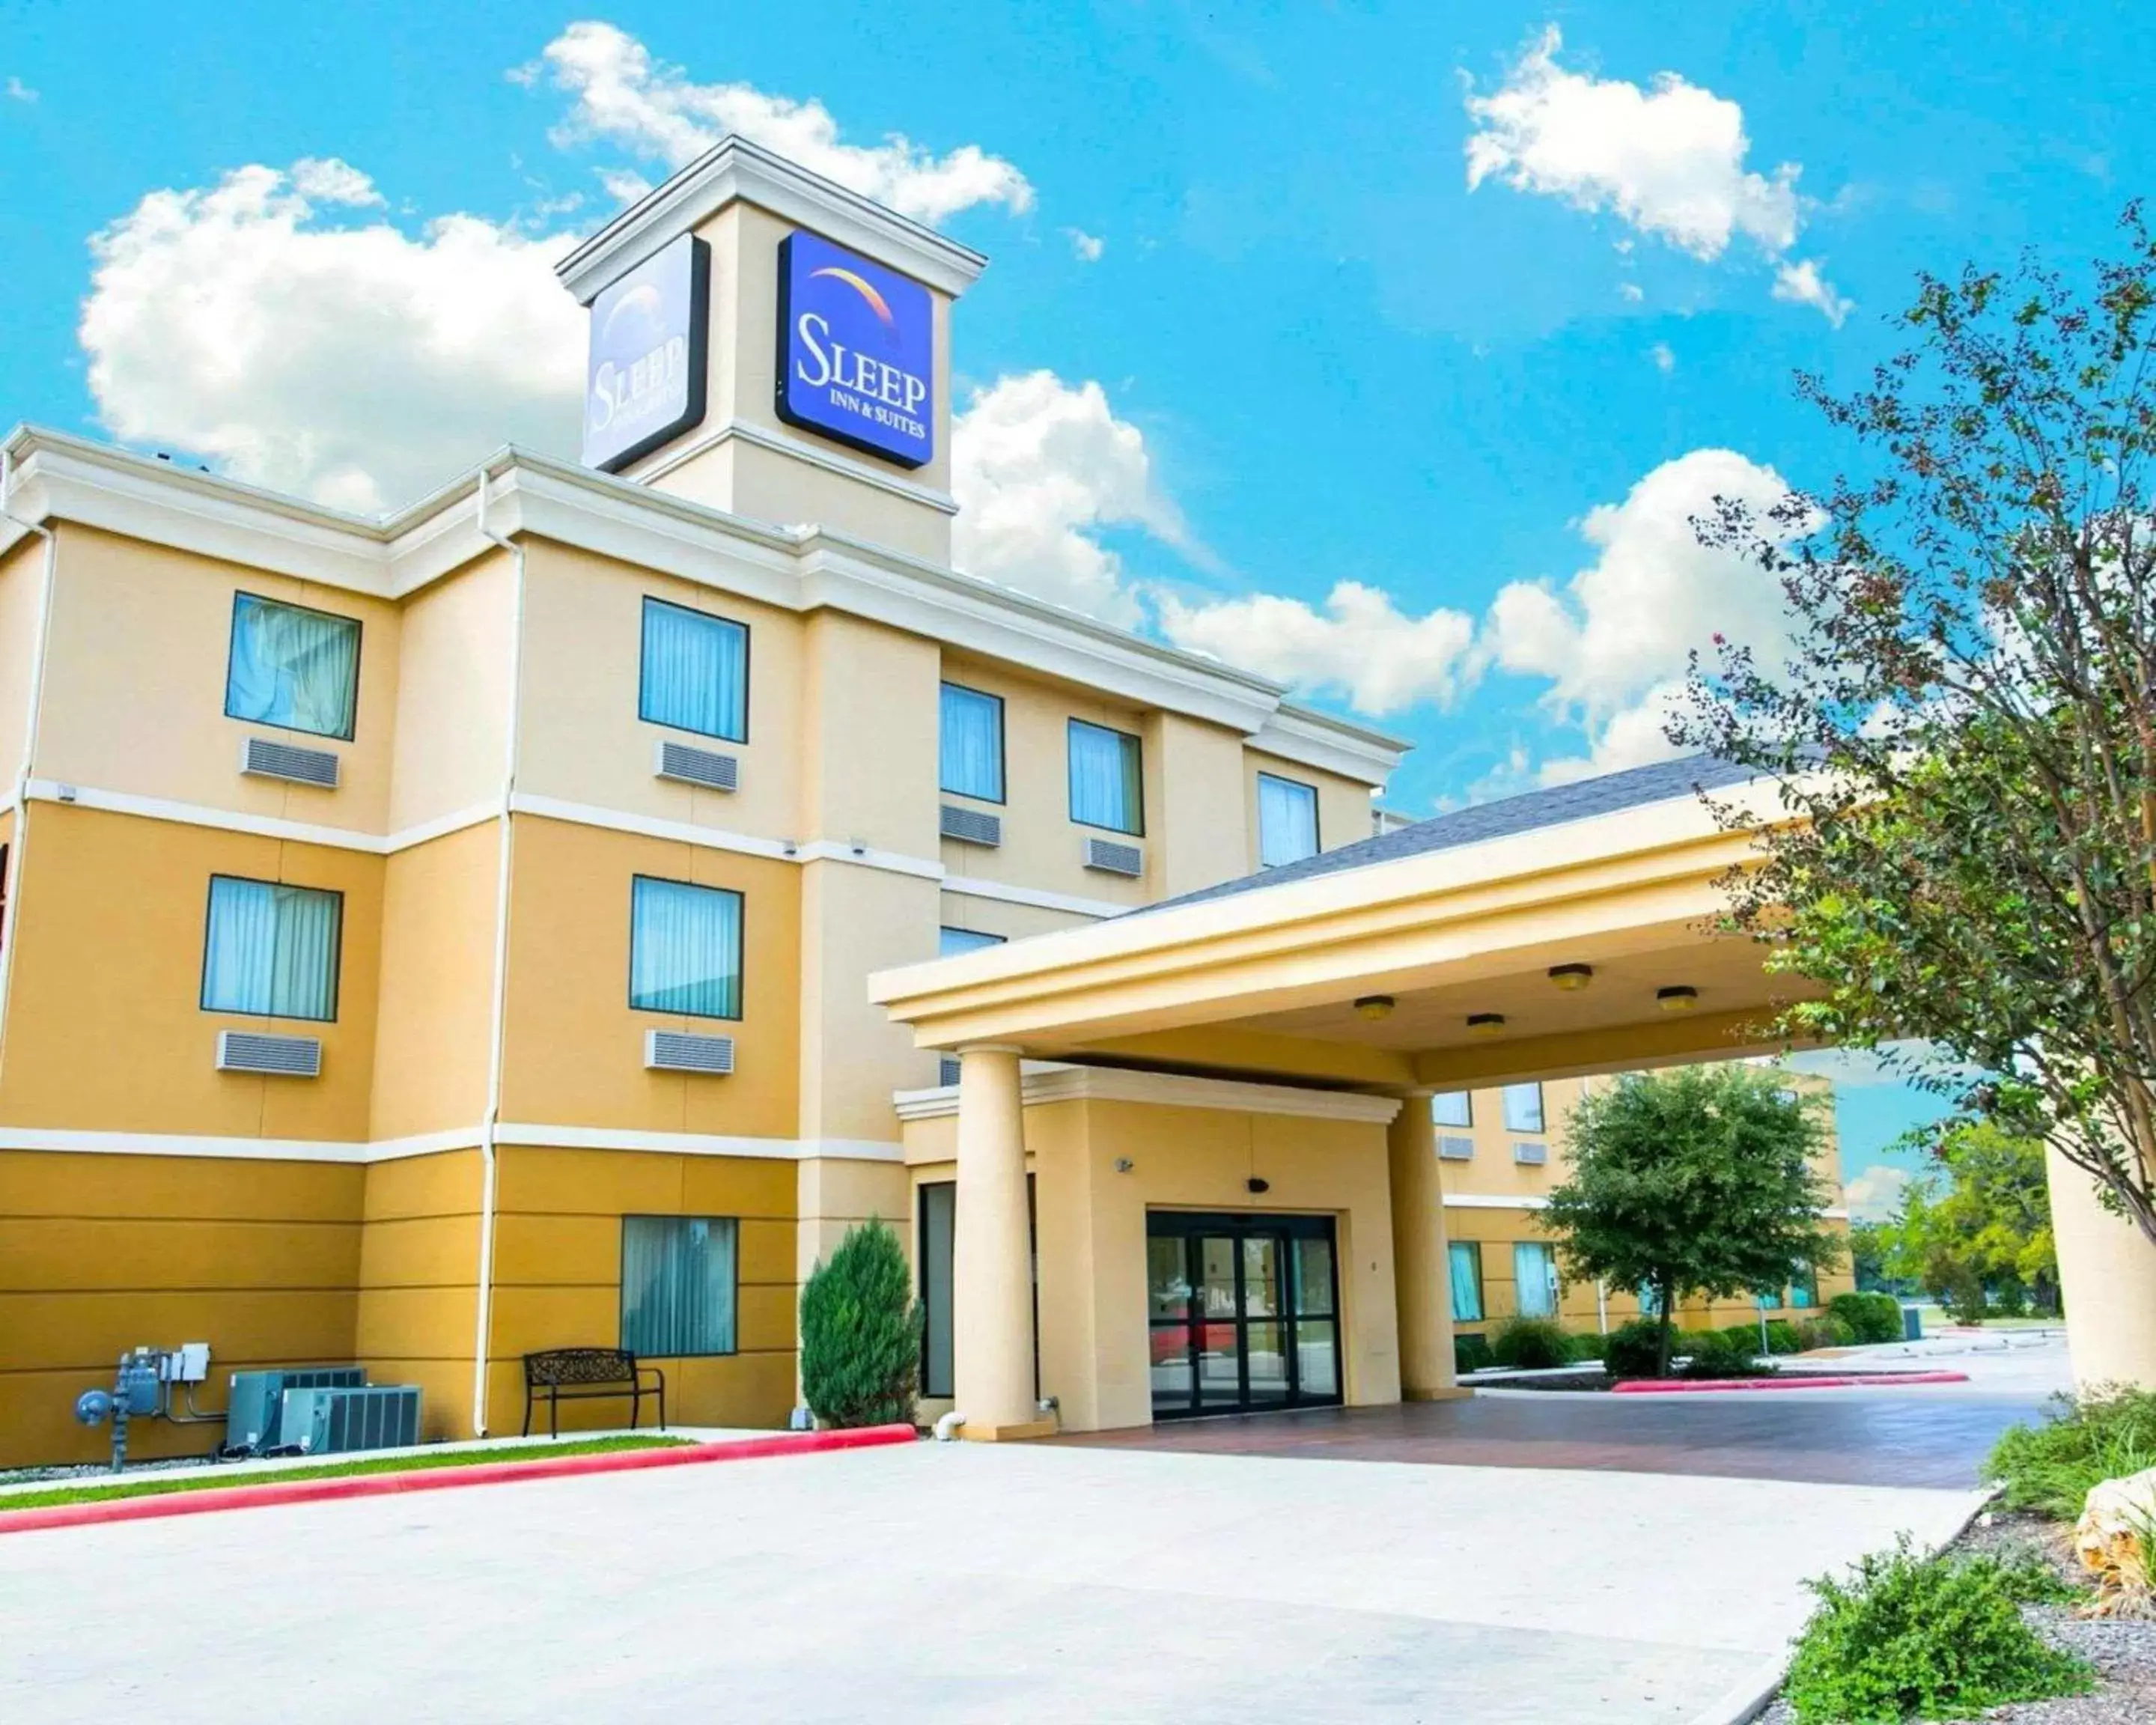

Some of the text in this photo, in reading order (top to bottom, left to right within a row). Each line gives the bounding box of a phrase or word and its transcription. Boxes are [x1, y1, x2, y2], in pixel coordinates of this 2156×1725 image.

[797, 312, 926, 415] SLEEP
[829, 388, 925, 440] INN & SUITES
